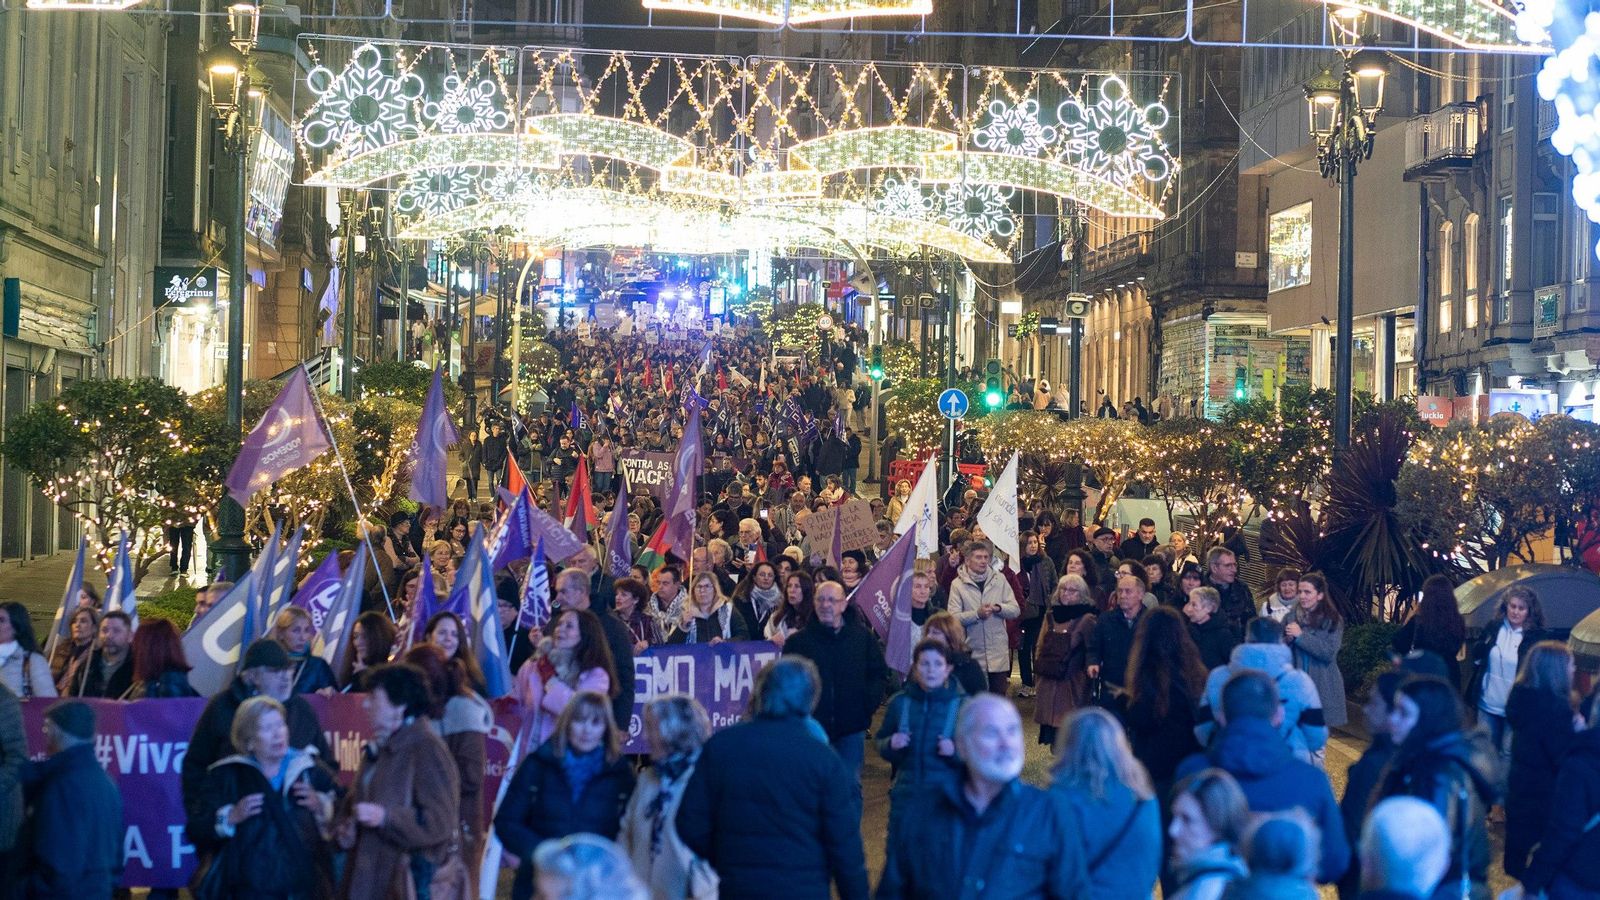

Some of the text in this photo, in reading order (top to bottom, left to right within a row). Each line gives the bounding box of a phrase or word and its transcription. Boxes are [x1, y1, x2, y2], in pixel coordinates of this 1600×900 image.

[165, 287, 214, 298] Peregrinus
[657, 461, 669, 471] AS
[714, 652, 782, 702] MAT
[95, 734, 189, 774] #Viva
